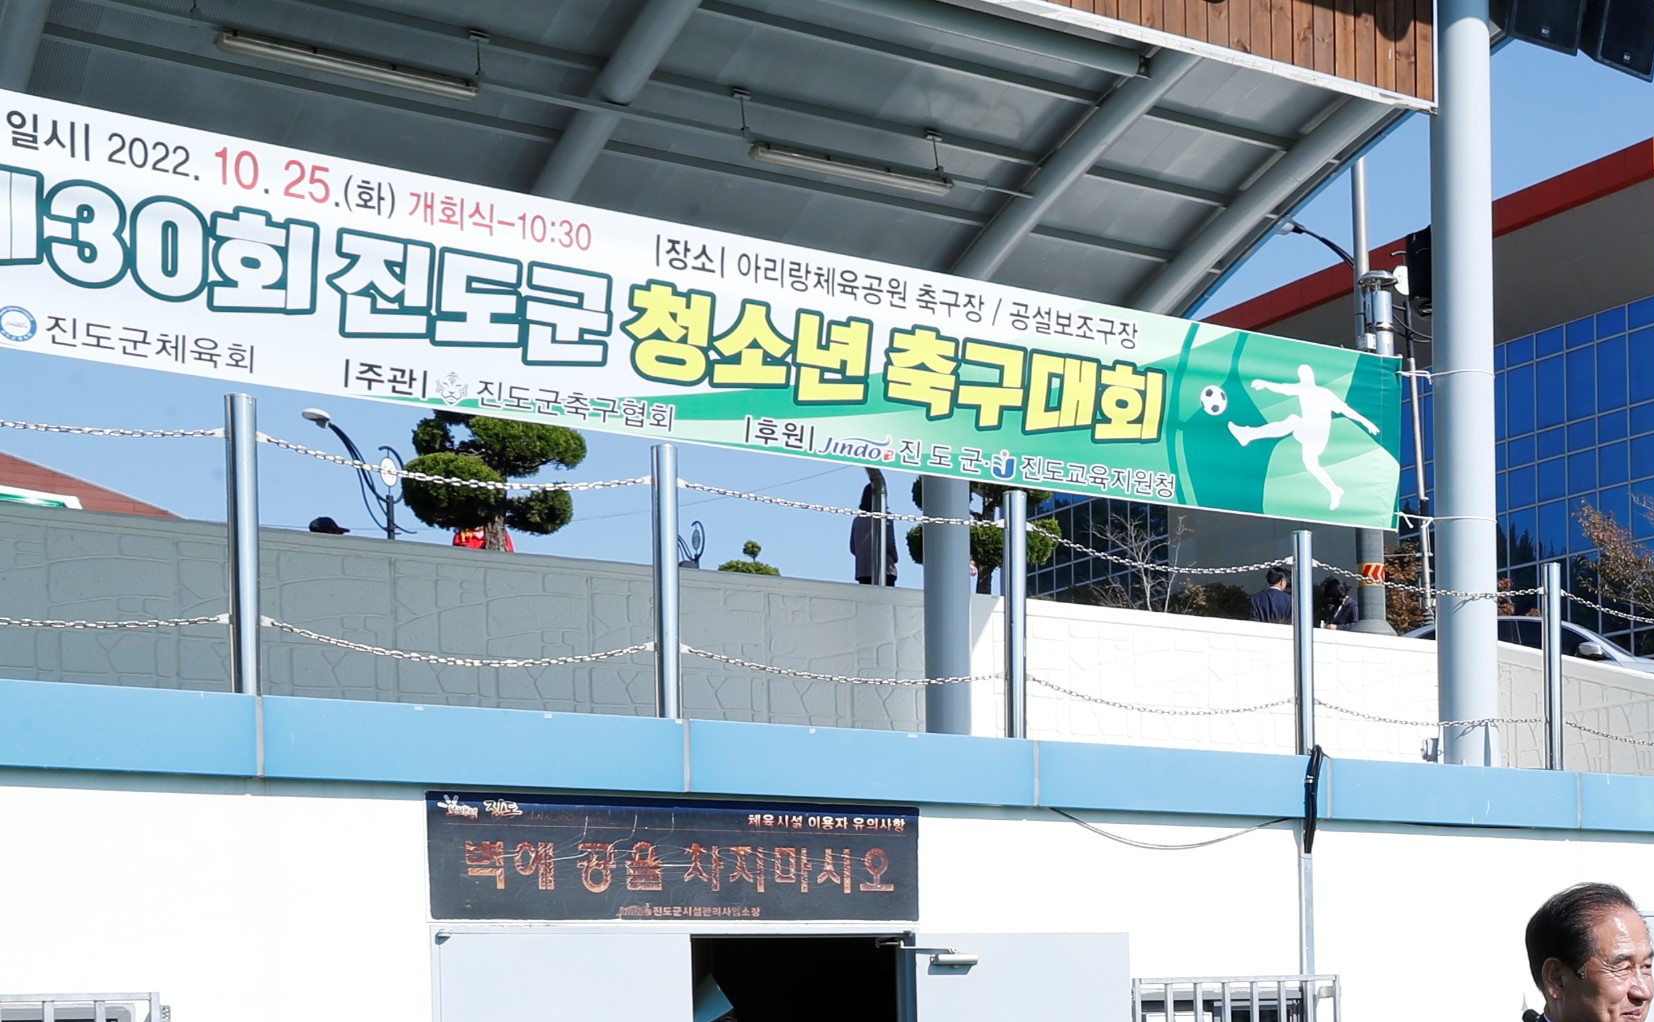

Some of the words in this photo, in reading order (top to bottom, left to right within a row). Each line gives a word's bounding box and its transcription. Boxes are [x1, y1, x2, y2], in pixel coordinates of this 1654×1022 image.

[107, 132, 200, 181] 2022.
[737, 251, 909, 311] 아리랑체육공원
[915, 286, 986, 324] 축구장
[1008, 300, 1139, 351] 공설보조구장
[45, 314, 256, 374] 진도군체육회
[327, 227, 612, 367] 진도군
[621, 277, 872, 405] 청소년
[883, 323, 1167, 444] 축구대회
[476, 379, 676, 432] 진도군축구협회
[1021, 455, 1177, 500] 진도교육지원청
[747, 814, 803, 829] 체육시설
[808, 816, 848, 830] 이용자
[853, 817, 906, 832] 유의사항
[577, 841, 663, 893] 공을
[683, 842, 894, 894] 차지마시오
